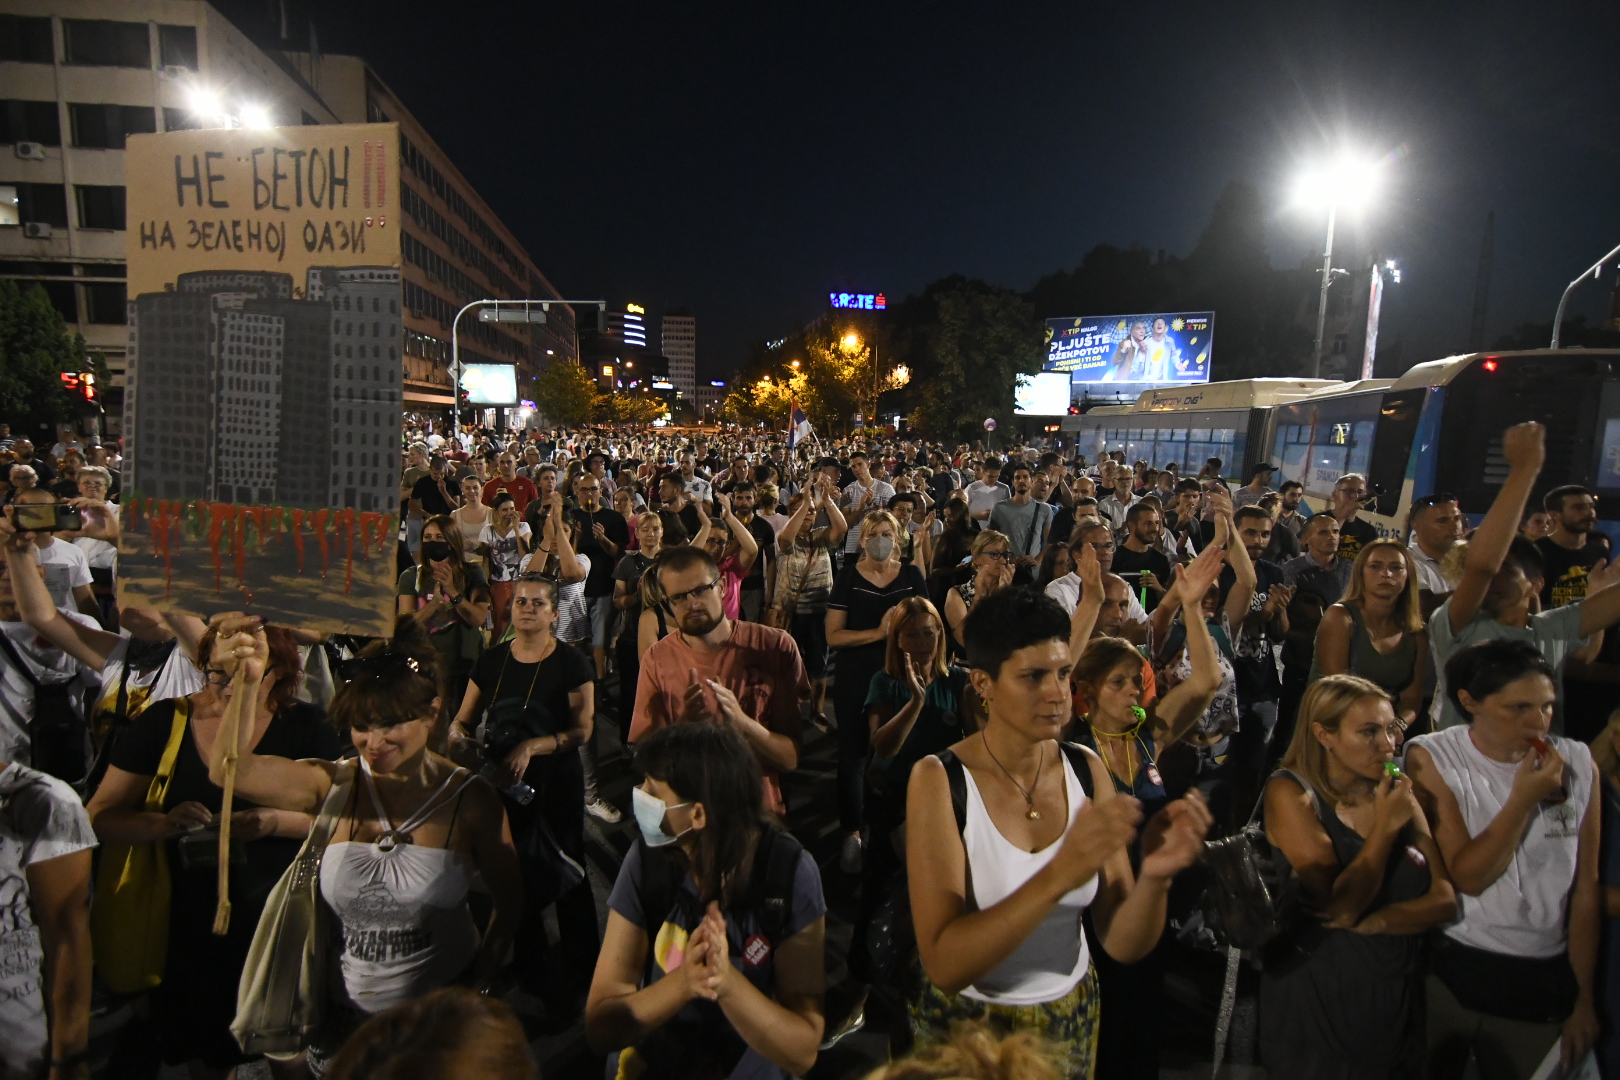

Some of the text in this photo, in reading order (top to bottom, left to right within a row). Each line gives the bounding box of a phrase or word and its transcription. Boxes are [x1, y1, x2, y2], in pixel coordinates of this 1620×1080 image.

[174, 151, 230, 209] НЕ
[250, 145, 350, 212] БЕТОН
[140, 219, 366, 262] НА ЗЕЛЕНОЈ ОАЗИ
[1048, 345, 1110, 361] DŽEKPOTOVI
[1050, 333, 1111, 352] PLJUŠTE
